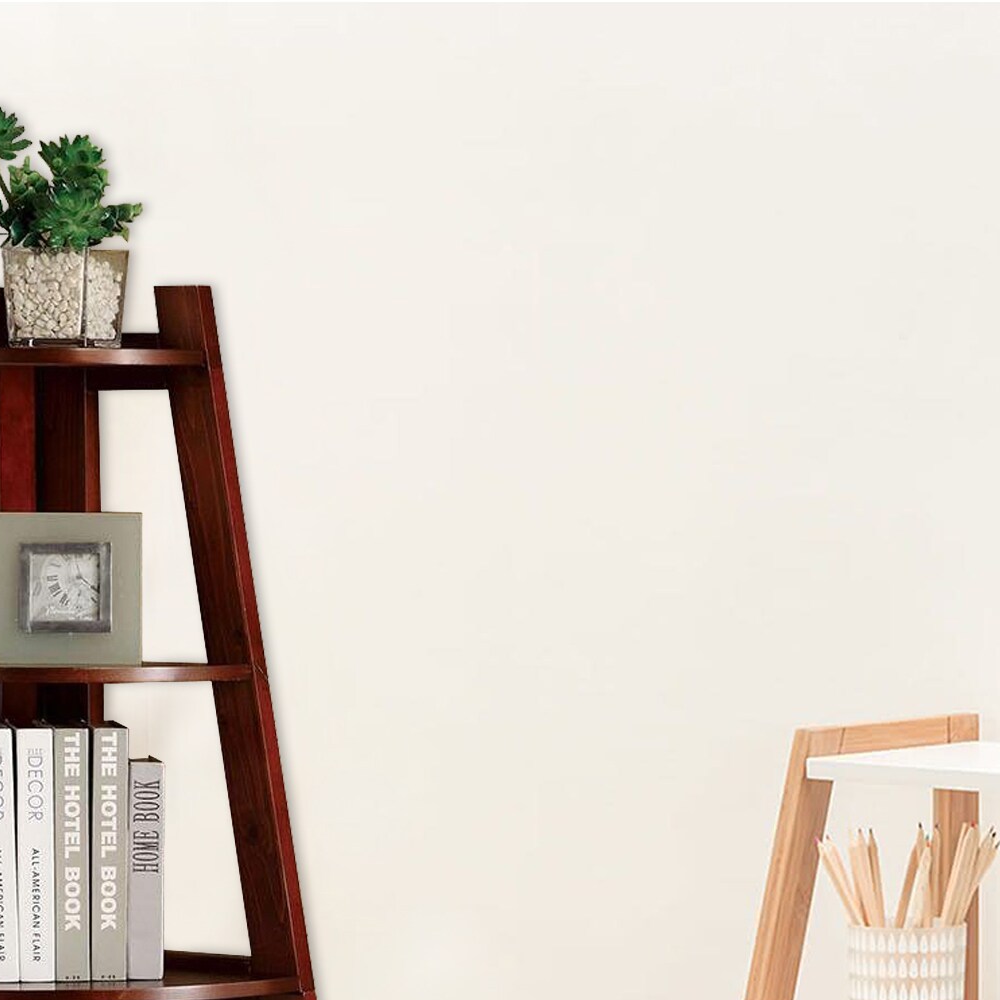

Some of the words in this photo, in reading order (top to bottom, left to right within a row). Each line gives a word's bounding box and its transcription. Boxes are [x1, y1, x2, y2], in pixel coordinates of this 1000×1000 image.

[64, 732, 80, 777] THE
[101, 732, 117, 776] THE
[28, 756, 43, 820] DECOR
[133, 779, 160, 823] BOOK
[64, 786, 80, 858] HOTEL
[101, 785, 117, 858] HOTEL
[133, 830, 159, 873] HOME
[32, 848, 41, 928] ALL-AMERICAN
[64, 867, 80, 931] BOOK
[101, 866, 117, 930] BOOK
[32, 933, 41, 961] FLAIR
